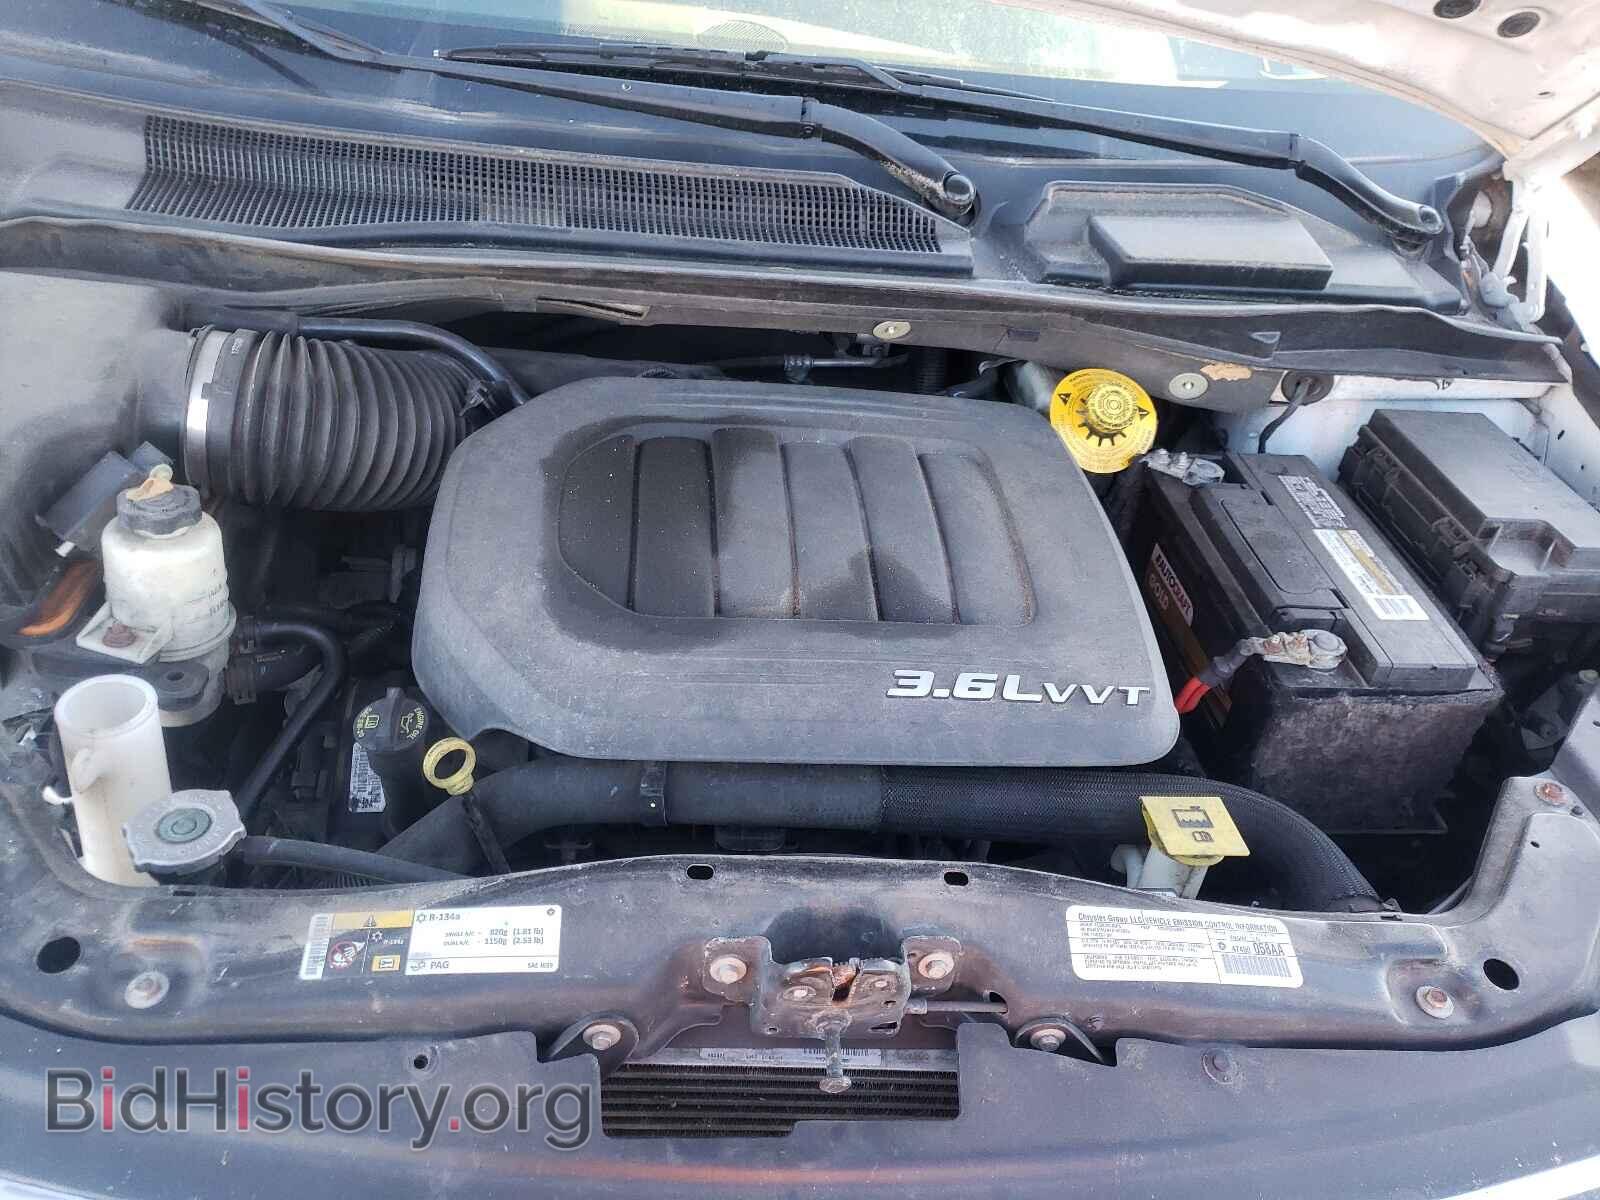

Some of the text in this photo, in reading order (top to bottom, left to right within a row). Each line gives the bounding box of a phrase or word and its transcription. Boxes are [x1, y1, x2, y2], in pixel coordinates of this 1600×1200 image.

[886, 669, 1151, 705] 3.6L VVT
[429, 913, 461, 922] R-134a
[1172, 918, 1204, 929] EMISSION
[1204, 920, 1234, 930] CONTROL
[1235, 922, 1278, 933] INFORMATION
[430, 960, 449, 970] PAG
